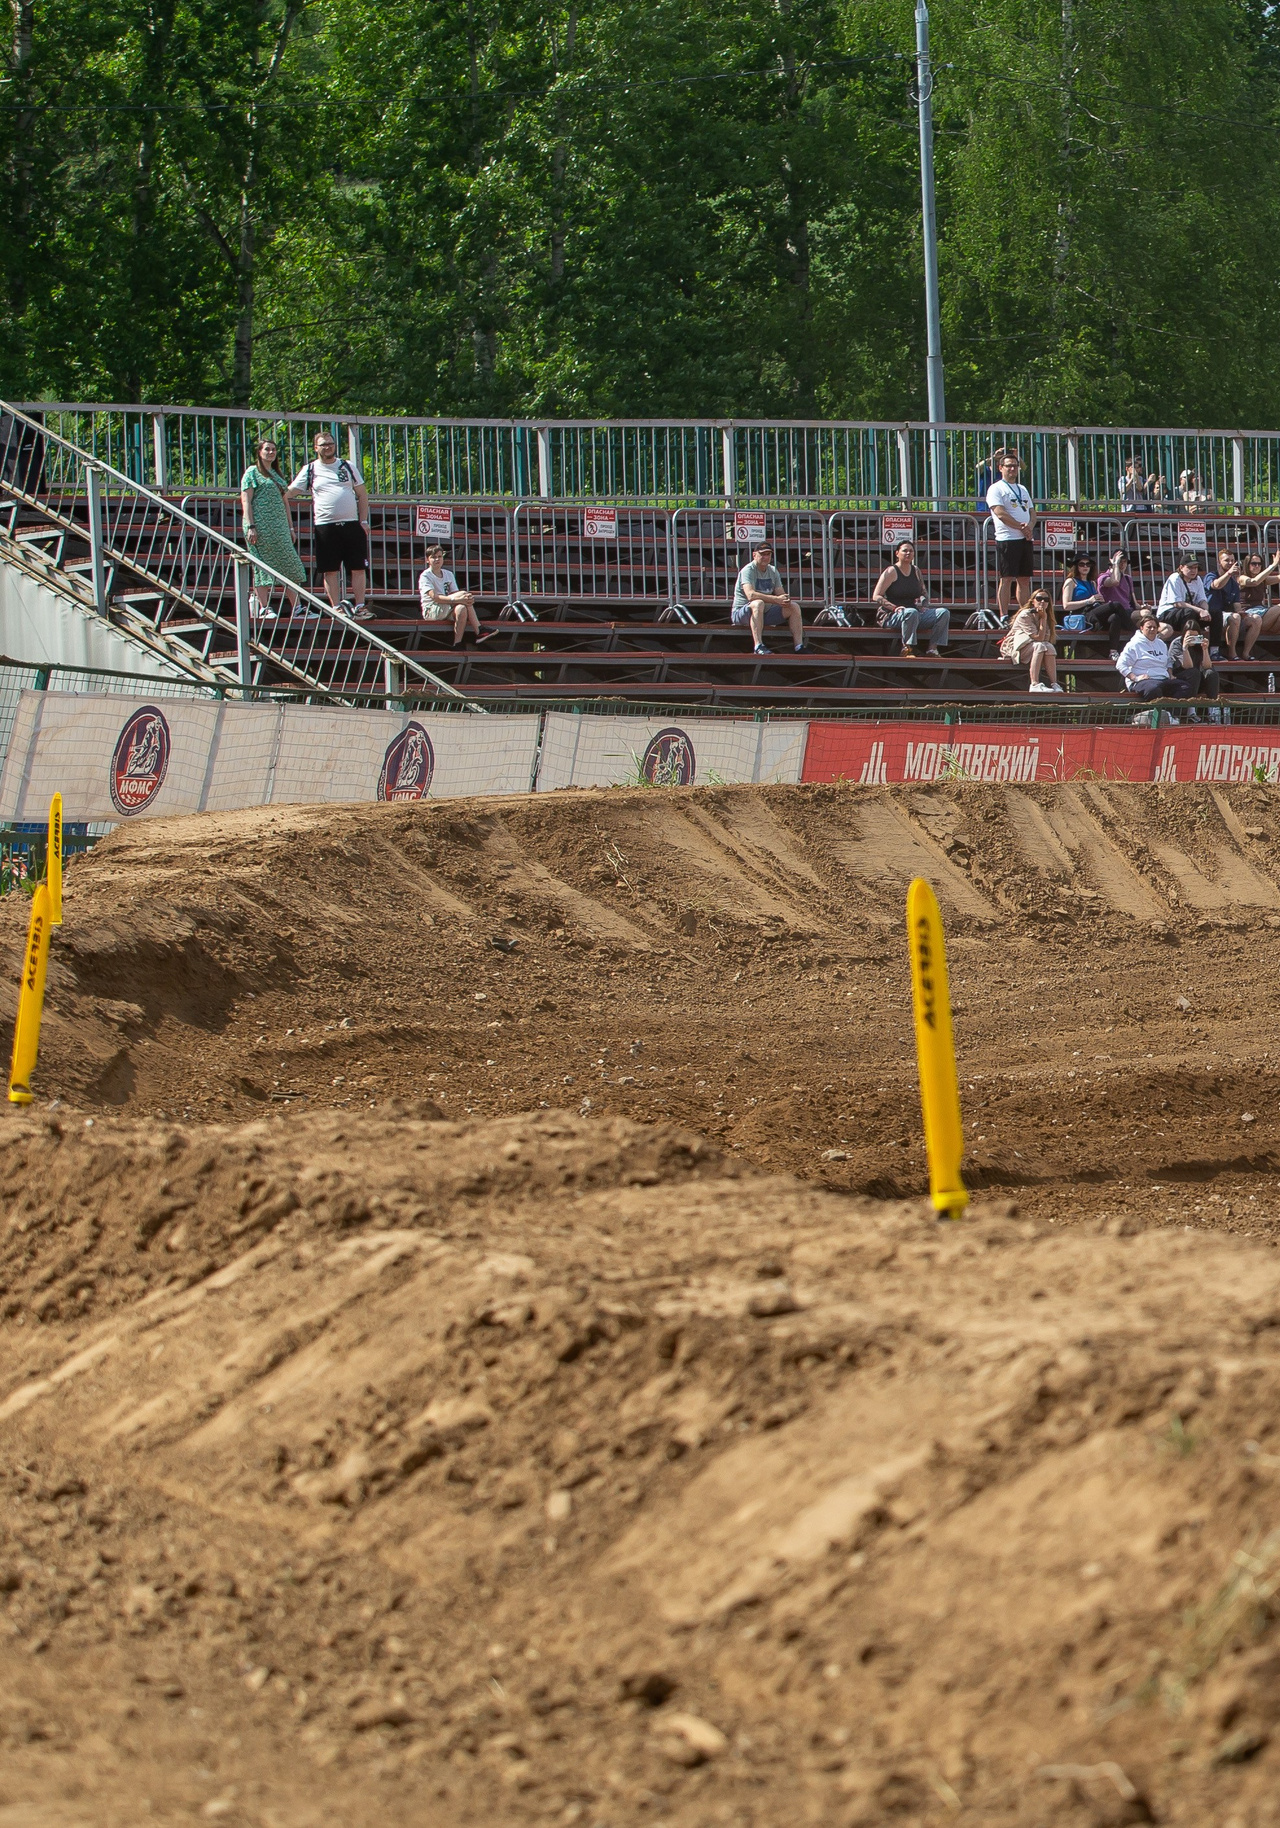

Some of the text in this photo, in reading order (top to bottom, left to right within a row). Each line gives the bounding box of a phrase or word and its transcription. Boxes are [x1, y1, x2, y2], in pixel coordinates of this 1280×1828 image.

[420, 506, 449, 514] ОПАСНАЯ
[904, 738, 1040, 781] МОСКОВСКИЙ
[119, 780, 154, 796] МФМС
[28, 916, 43, 992] ACERBIS
